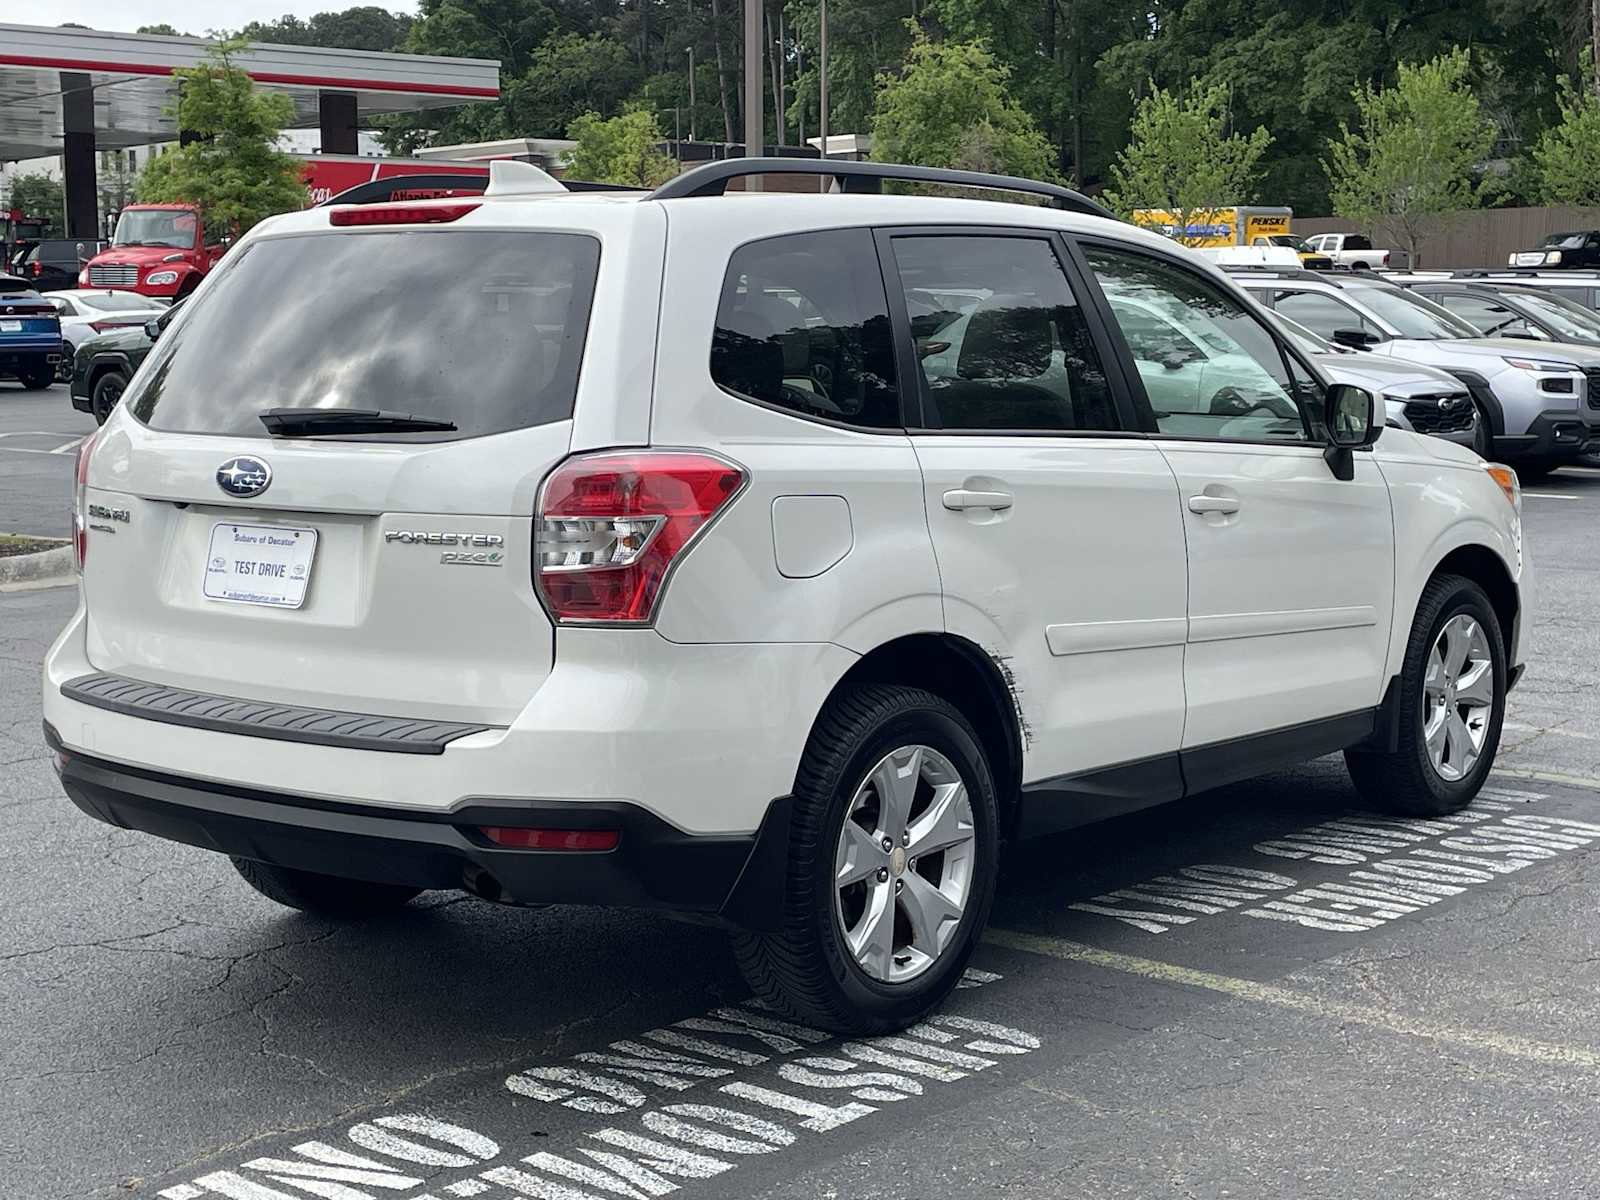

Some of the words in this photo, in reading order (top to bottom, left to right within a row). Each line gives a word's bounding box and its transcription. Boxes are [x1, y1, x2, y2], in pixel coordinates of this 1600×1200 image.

[1251, 217, 1287, 225] PENSKE
[234, 534, 257, 544] Subaru
[259, 536, 267, 544] of
[385, 530, 504, 548] FORESTER
[235, 560, 256, 575] TEST
[258, 563, 286, 578] DRIVE
[1239, 815, 1600, 933] CUSTOMER
[1067, 863, 1298, 934] ONLY
